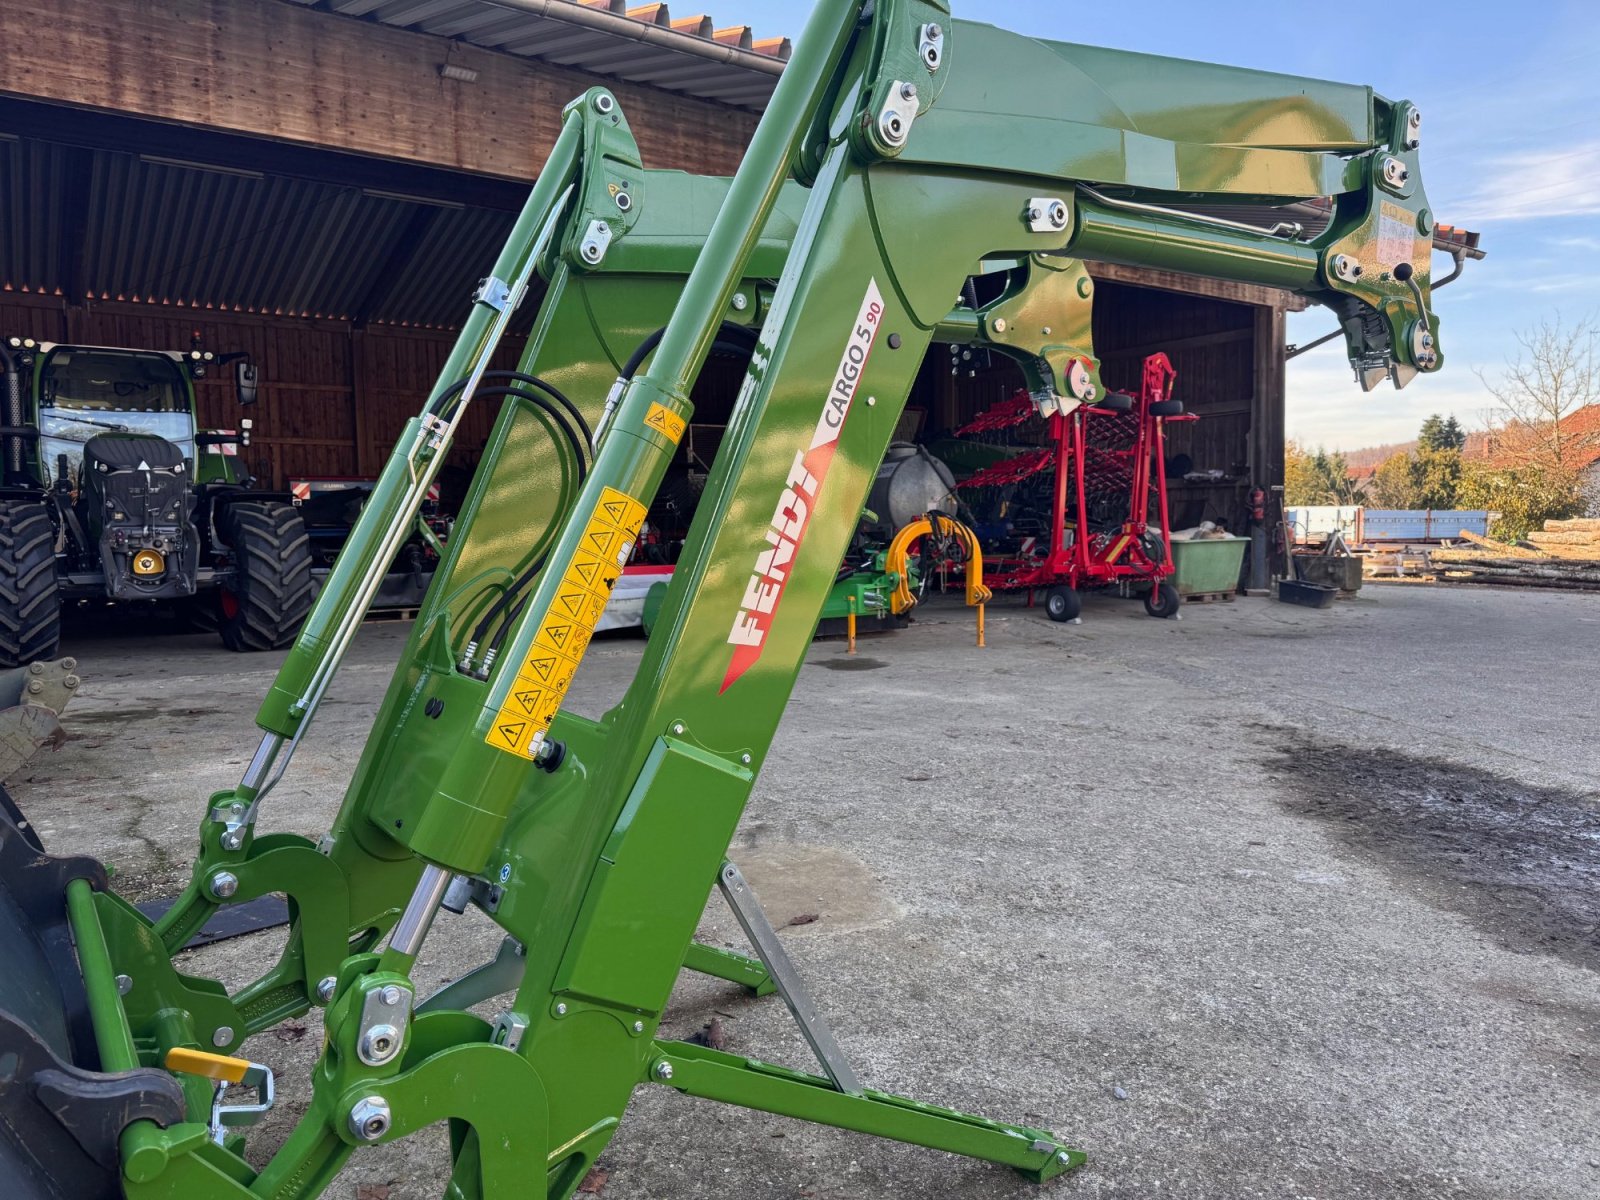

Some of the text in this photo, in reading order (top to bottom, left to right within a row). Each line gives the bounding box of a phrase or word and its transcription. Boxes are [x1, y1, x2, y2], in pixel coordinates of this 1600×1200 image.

[825, 302, 881, 428] CARGO 5 90
[727, 449, 818, 646] FENDT
